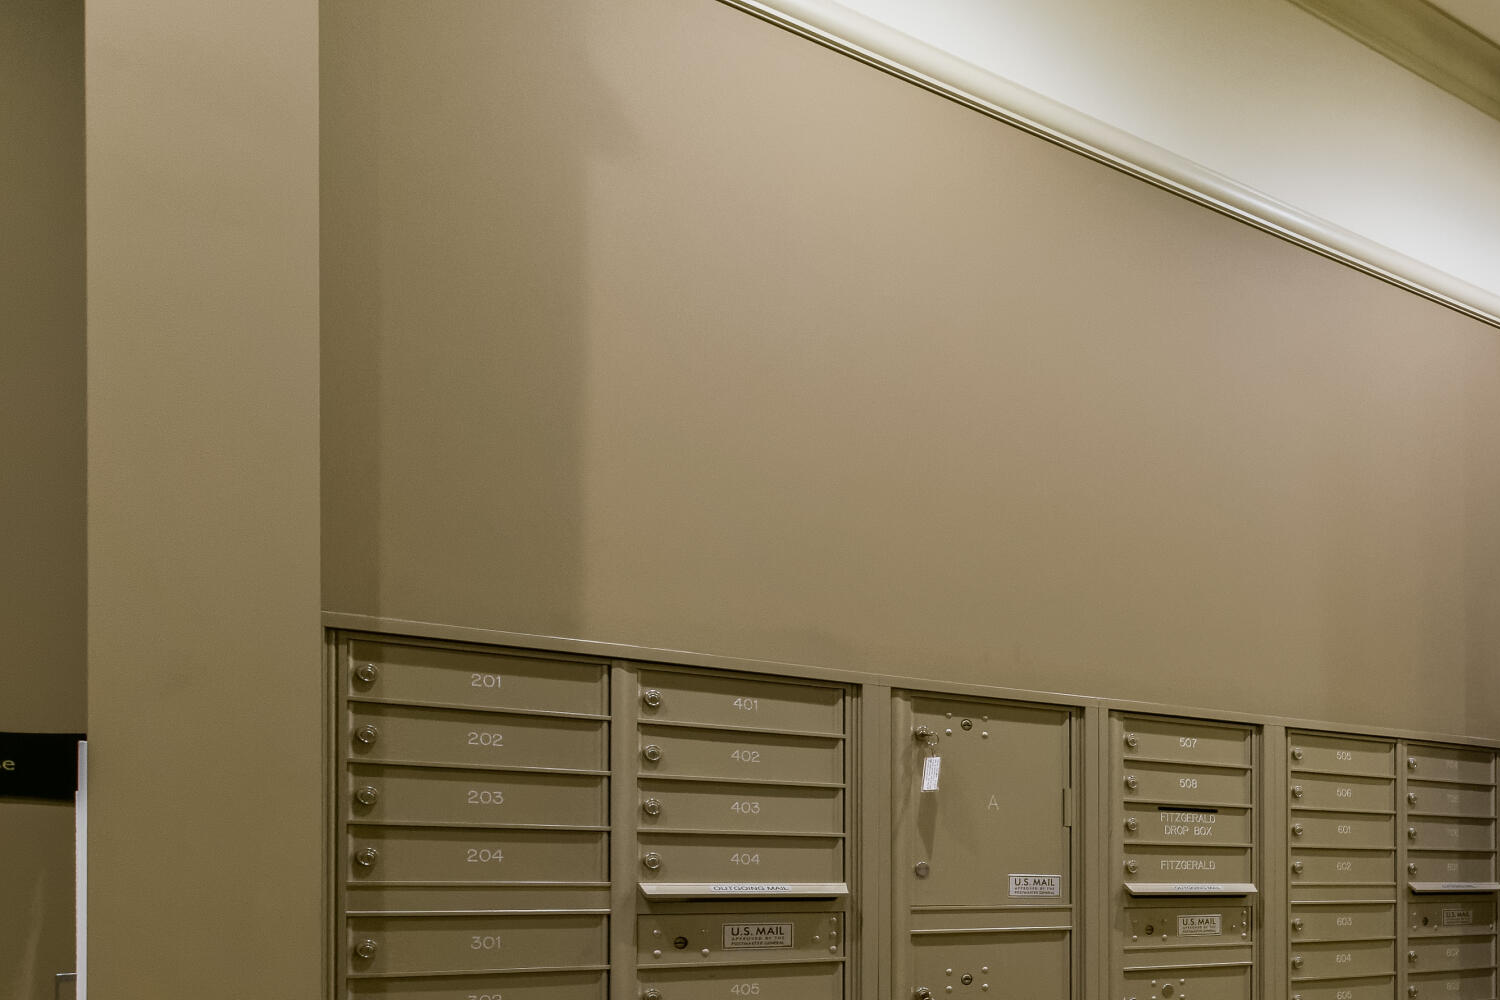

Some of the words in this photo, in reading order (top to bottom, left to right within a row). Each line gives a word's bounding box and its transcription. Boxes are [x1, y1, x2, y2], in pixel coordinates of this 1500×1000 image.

[470, 673, 502, 689] 201
[732, 697, 759, 711] 401
[467, 731, 504, 747] 202
[1178, 737, 1198, 748] 507
[730, 750, 761, 763] 402
[0, 760, 15, 770] e
[1178, 778, 1198, 789] 508
[467, 790, 504, 805] 203
[987, 794, 999, 811] A
[730, 801, 761, 814] 403
[1160, 812, 1216, 824] FITZGERALD
[1164, 825, 1189, 835] DROP
[1193, 826, 1212, 836] BOX
[466, 848, 504, 863] 204
[730, 852, 760, 866] 404
[1160, 860, 1216, 871] FITZGERALD
[1014, 878, 1031, 886] U.S.
[1182, 918, 1196, 926] U.S.
[731, 927, 753, 936] U.S.
[755, 926, 784, 935] MAIL
[469, 935, 502, 950] 301
[730, 982, 760, 996] 405
